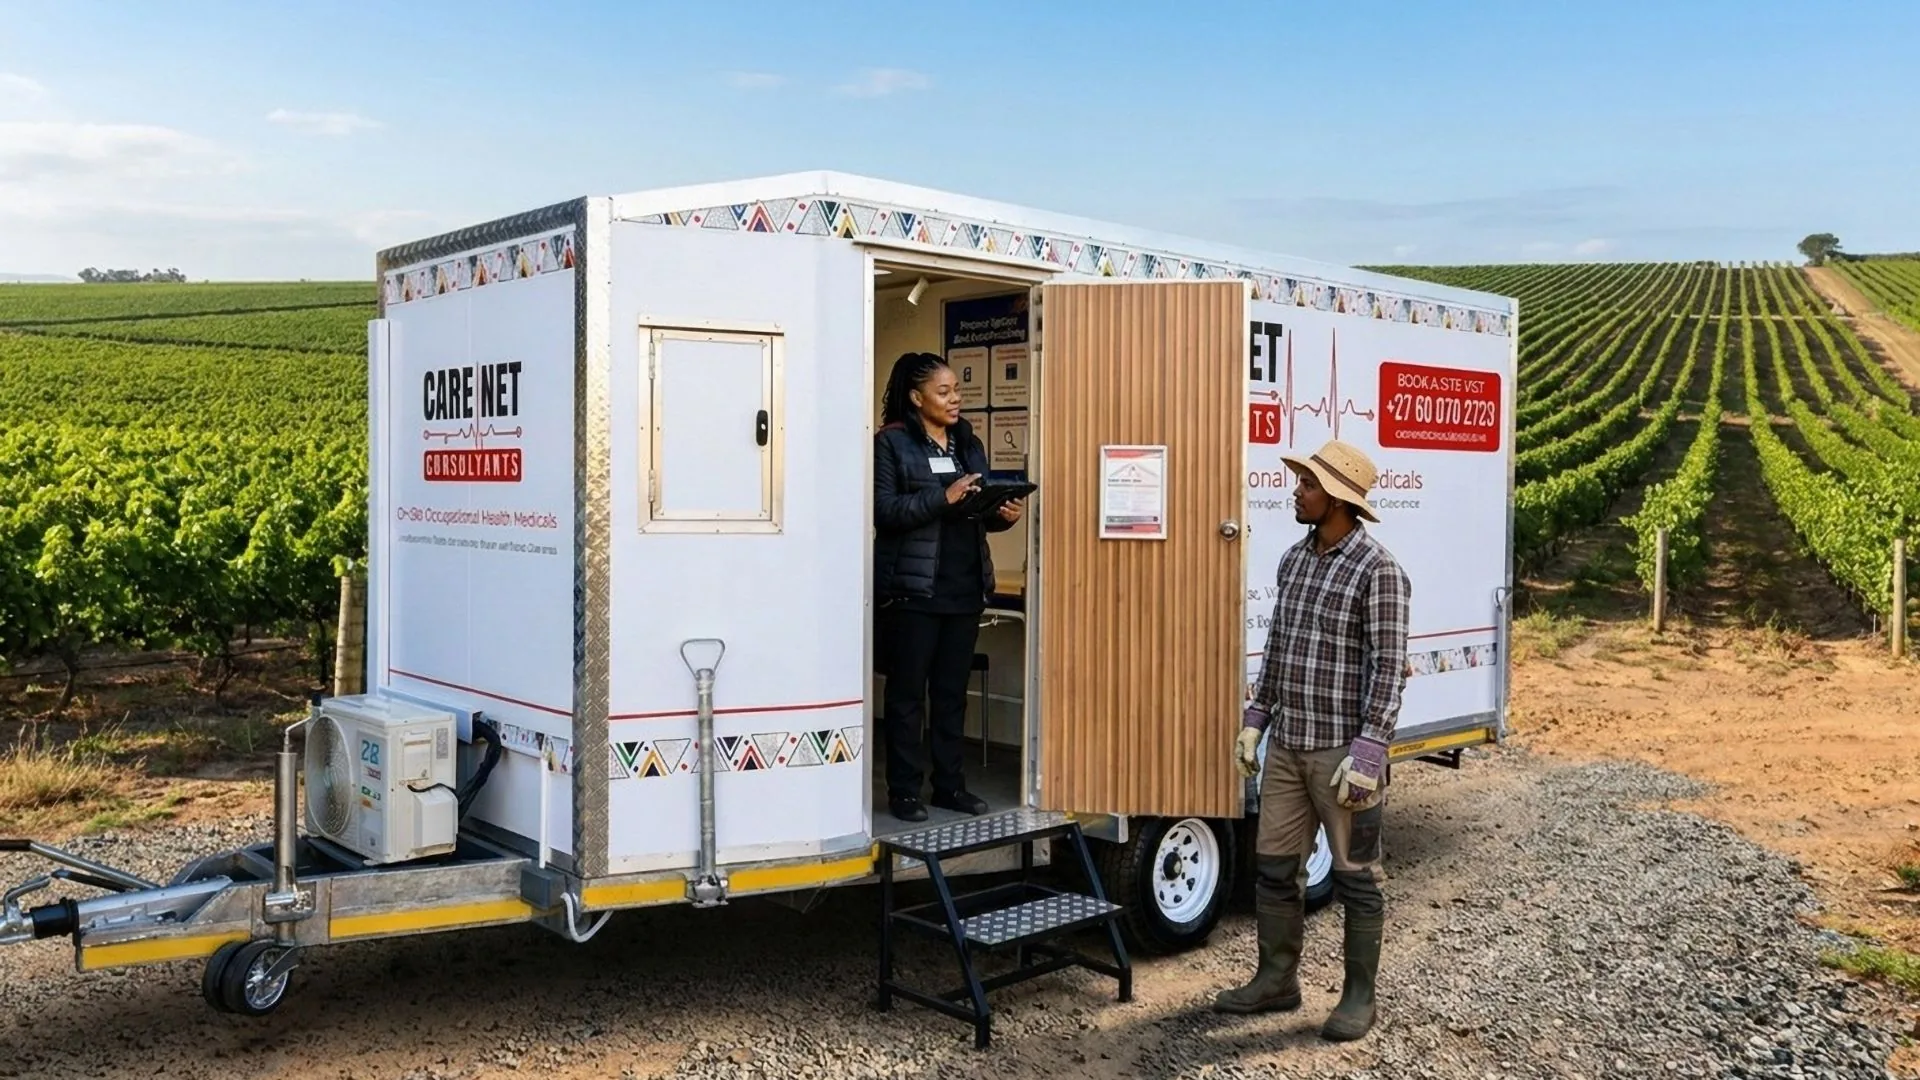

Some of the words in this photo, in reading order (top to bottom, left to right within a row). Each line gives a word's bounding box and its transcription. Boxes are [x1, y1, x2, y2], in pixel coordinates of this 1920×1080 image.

[424, 367, 473, 420] CARE
[481, 361, 522, 418] NET
[1252, 410, 1275, 438] TS
[1386, 393, 1412, 421] +27
[1416, 395, 1433, 424] 60
[1436, 397, 1461, 425] 070
[1248, 466, 1287, 488] onal
